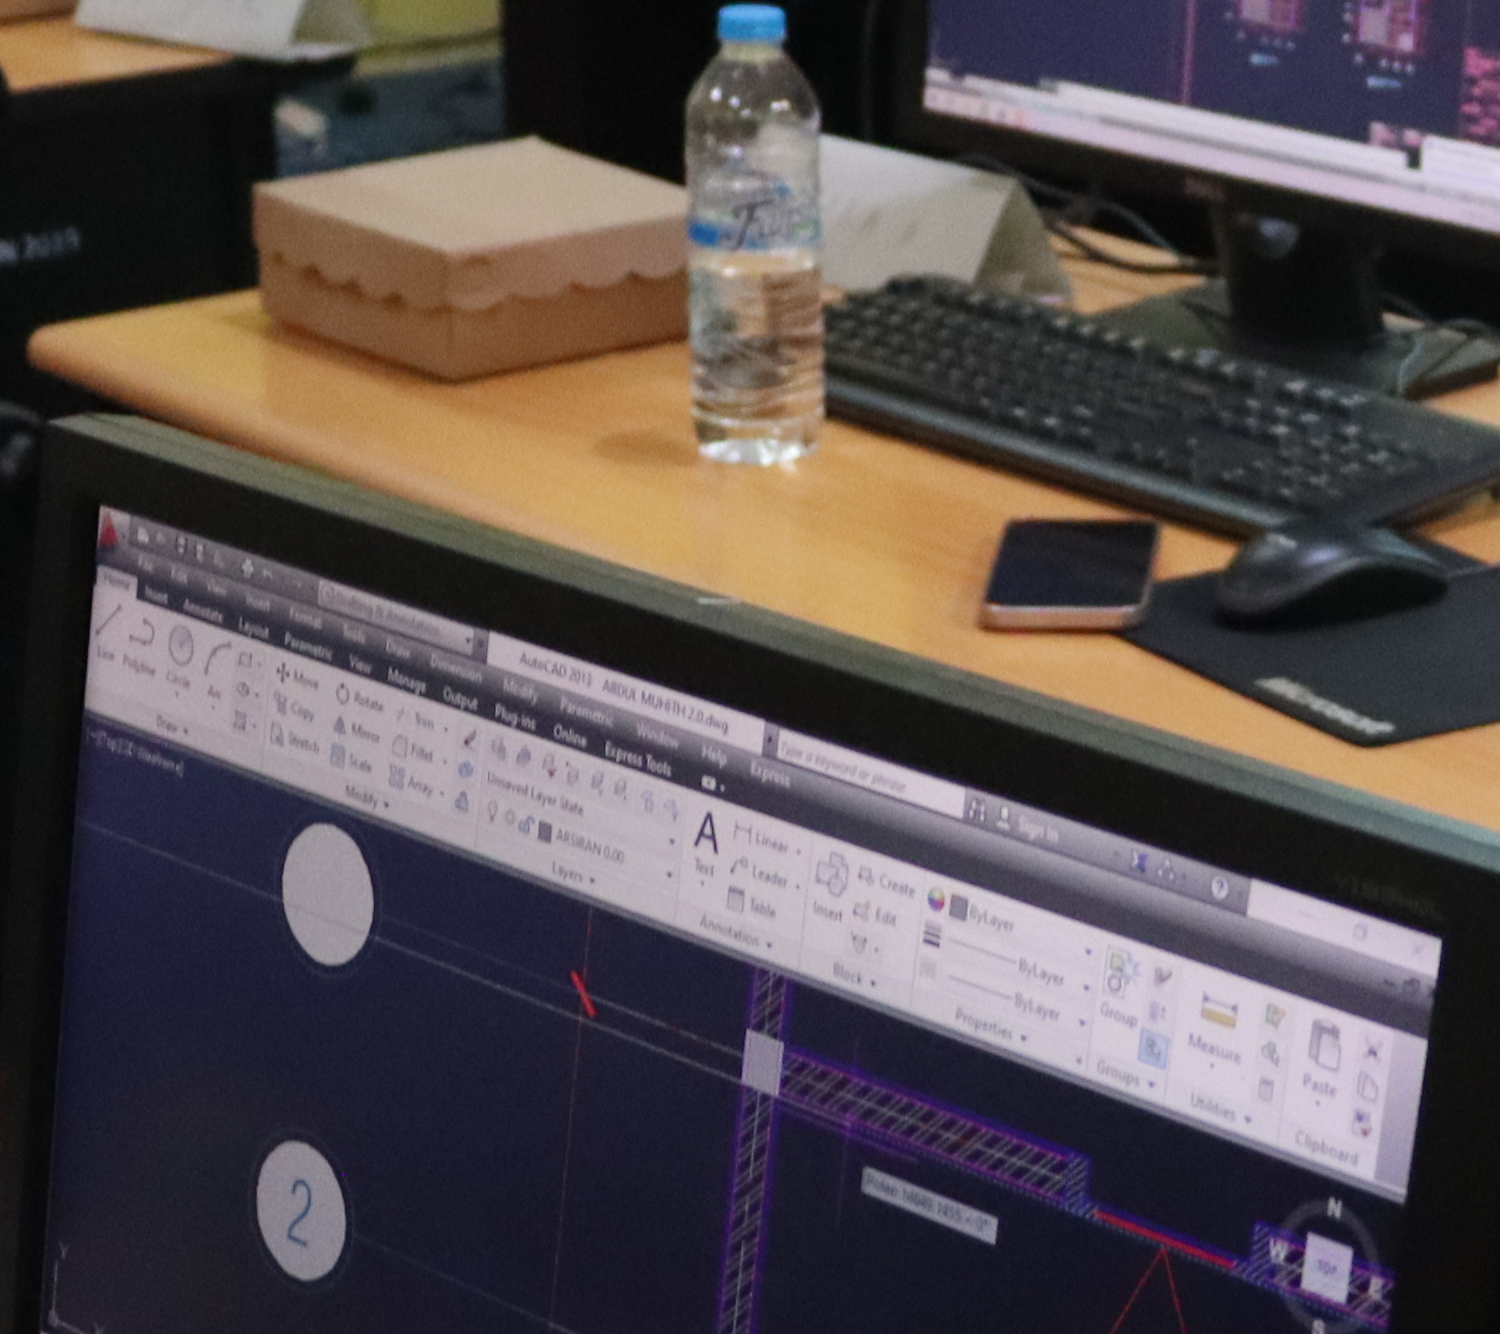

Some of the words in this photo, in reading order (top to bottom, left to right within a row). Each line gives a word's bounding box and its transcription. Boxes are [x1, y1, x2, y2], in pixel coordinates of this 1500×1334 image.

[183, 598, 224, 624] Annotate
[238, 616, 269, 640] Layout
[284, 631, 332, 661] Parametric
[387, 667, 427, 695] Manage
[442, 686, 479, 712] Output
[493, 702, 537, 733] Plug-ins
[553, 723, 588, 749] Online
[603, 740, 644, 770] Express
[646, 753, 673, 778] Tools
[293, 670, 319, 691] Move
[519, 651, 568, 679] AutoCAD
[601, 678, 637, 703] ABDUL
[290, 700, 315, 723] Copy
[353, 692, 384, 714] Rotate
[288, 731, 321, 755] Stretch
[350, 723, 381, 745] Mirror
[502, 676, 539, 705] Modify
[635, 720, 680, 750] Window
[702, 744, 728, 768] Help
[750, 761, 791, 788] Express
[409, 742, 434, 764] Fillet
[345, 784, 379, 811] Modify
[407, 775, 434, 798] Array
[486, 770, 529, 797] Unsaved
[531, 783, 558, 807] Layer
[559, 792, 585, 817] State
[693, 811, 719, 855] A
[755, 827, 789, 854] Linear
[602, 842, 625, 863] 0.00
[551, 860, 584, 885] Layers
[751, 863, 788, 889] Leader
[878, 873, 916, 899] Create
[749, 897, 777, 919] Table
[812, 900, 843, 922] Insert
[874, 907, 897, 927] Edit
[967, 904, 1015, 933] ByLayer
[700, 914, 760, 948] Annotation
[832, 961, 863, 984] Block
[1018, 957, 1065, 988] ByLayer
[1014, 991, 1061, 1022] ByLayer
[1100, 1002, 1139, 1030] Group
[954, 1008, 1014, 1043] Properties
[1188, 1033, 1242, 1065] Measure
[1097, 1060, 1141, 1089] Groups
[1302, 1072, 1338, 1099] Paste
[1190, 1092, 1237, 1123] Utilities
[1295, 1129, 1359, 1167] Clipboard
[286, 1178, 315, 1247] 2
[1326, 1195, 1343, 1218] N
